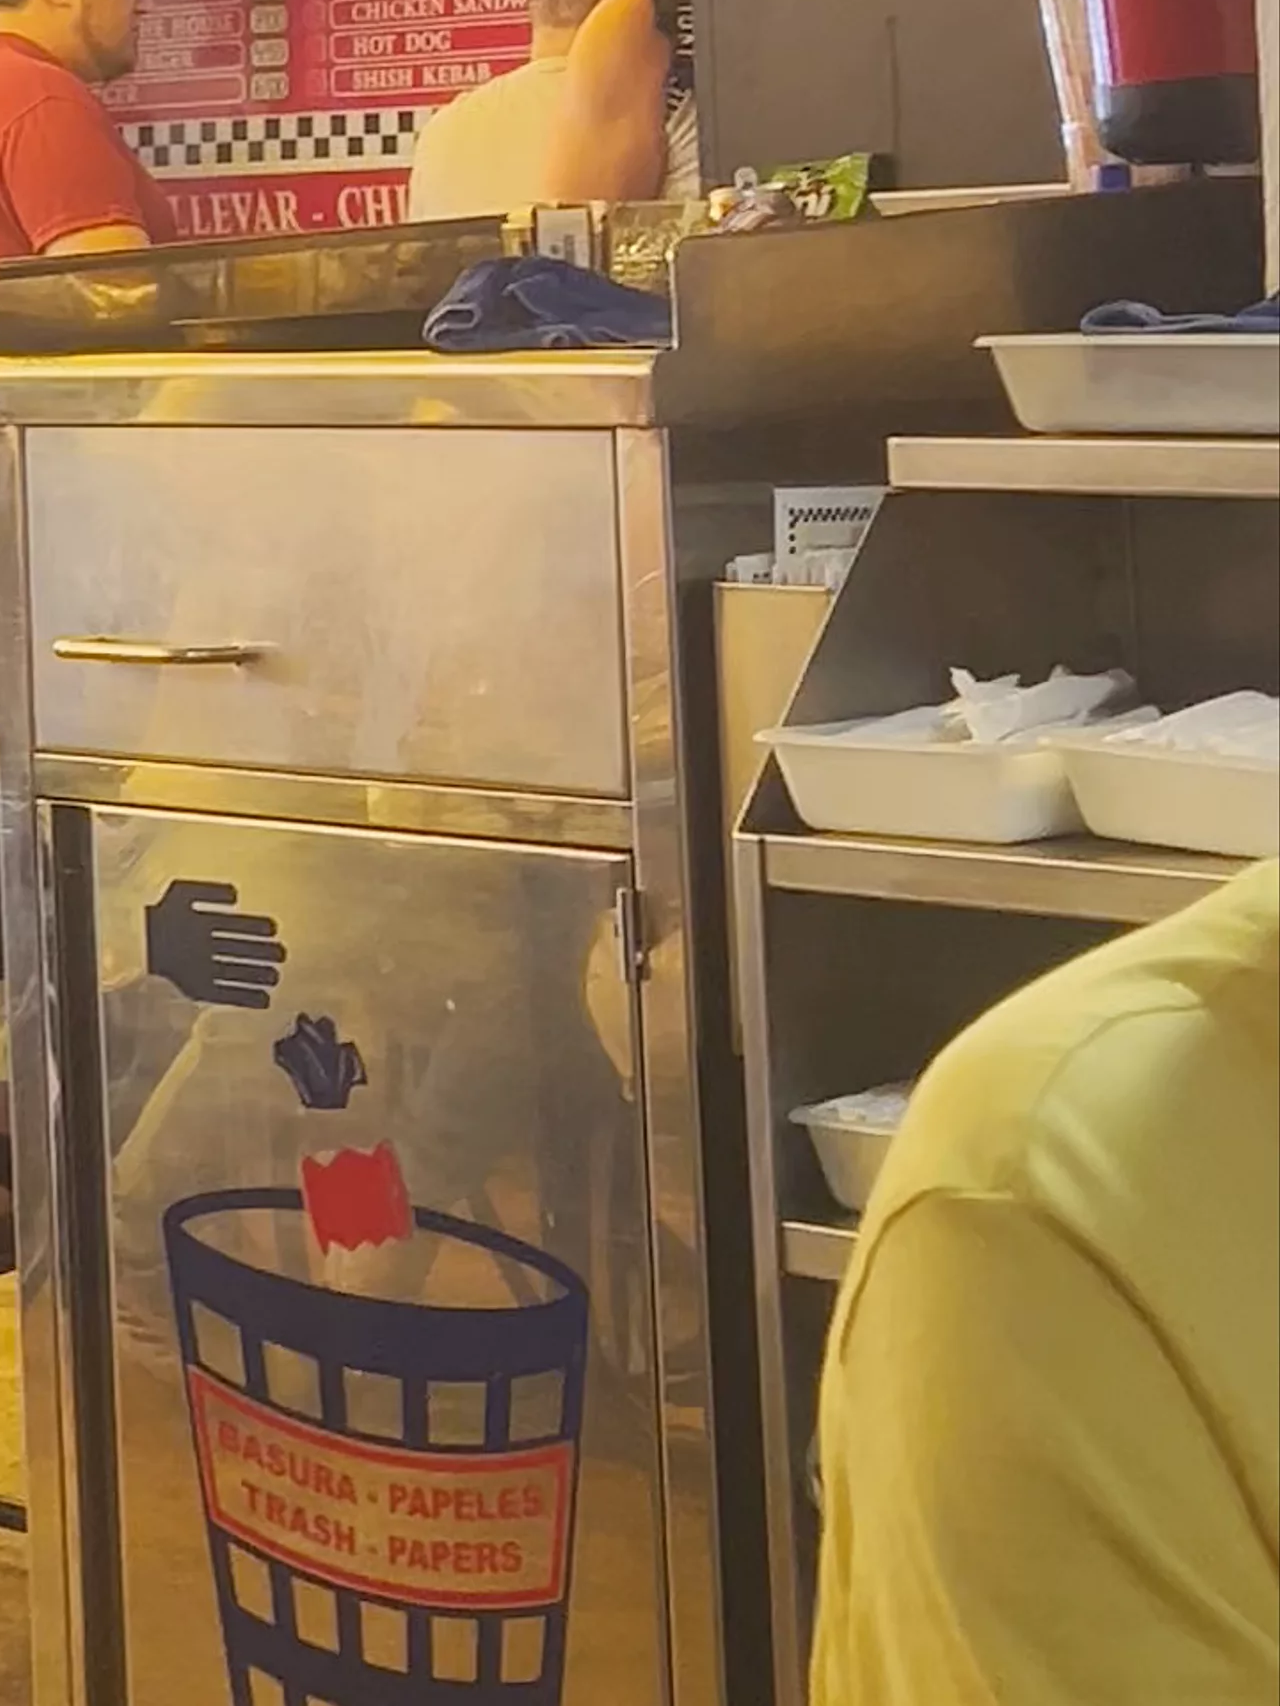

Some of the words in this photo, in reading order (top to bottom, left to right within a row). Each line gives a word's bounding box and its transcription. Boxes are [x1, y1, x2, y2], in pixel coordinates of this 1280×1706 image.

[353, 36, 397, 56] HOT
[405, 30, 452, 52] DOG
[353, 67, 413, 90] SHISH
[422, 62, 490, 87] KEBAB
[167, 188, 299, 236] LLEVAR
[217, 1420, 359, 1506] BASURA
[388, 1482, 546, 1521] PAPELES
[240, 1478, 357, 1556] TRASH
[388, 1535, 523, 1574] PAPERS
